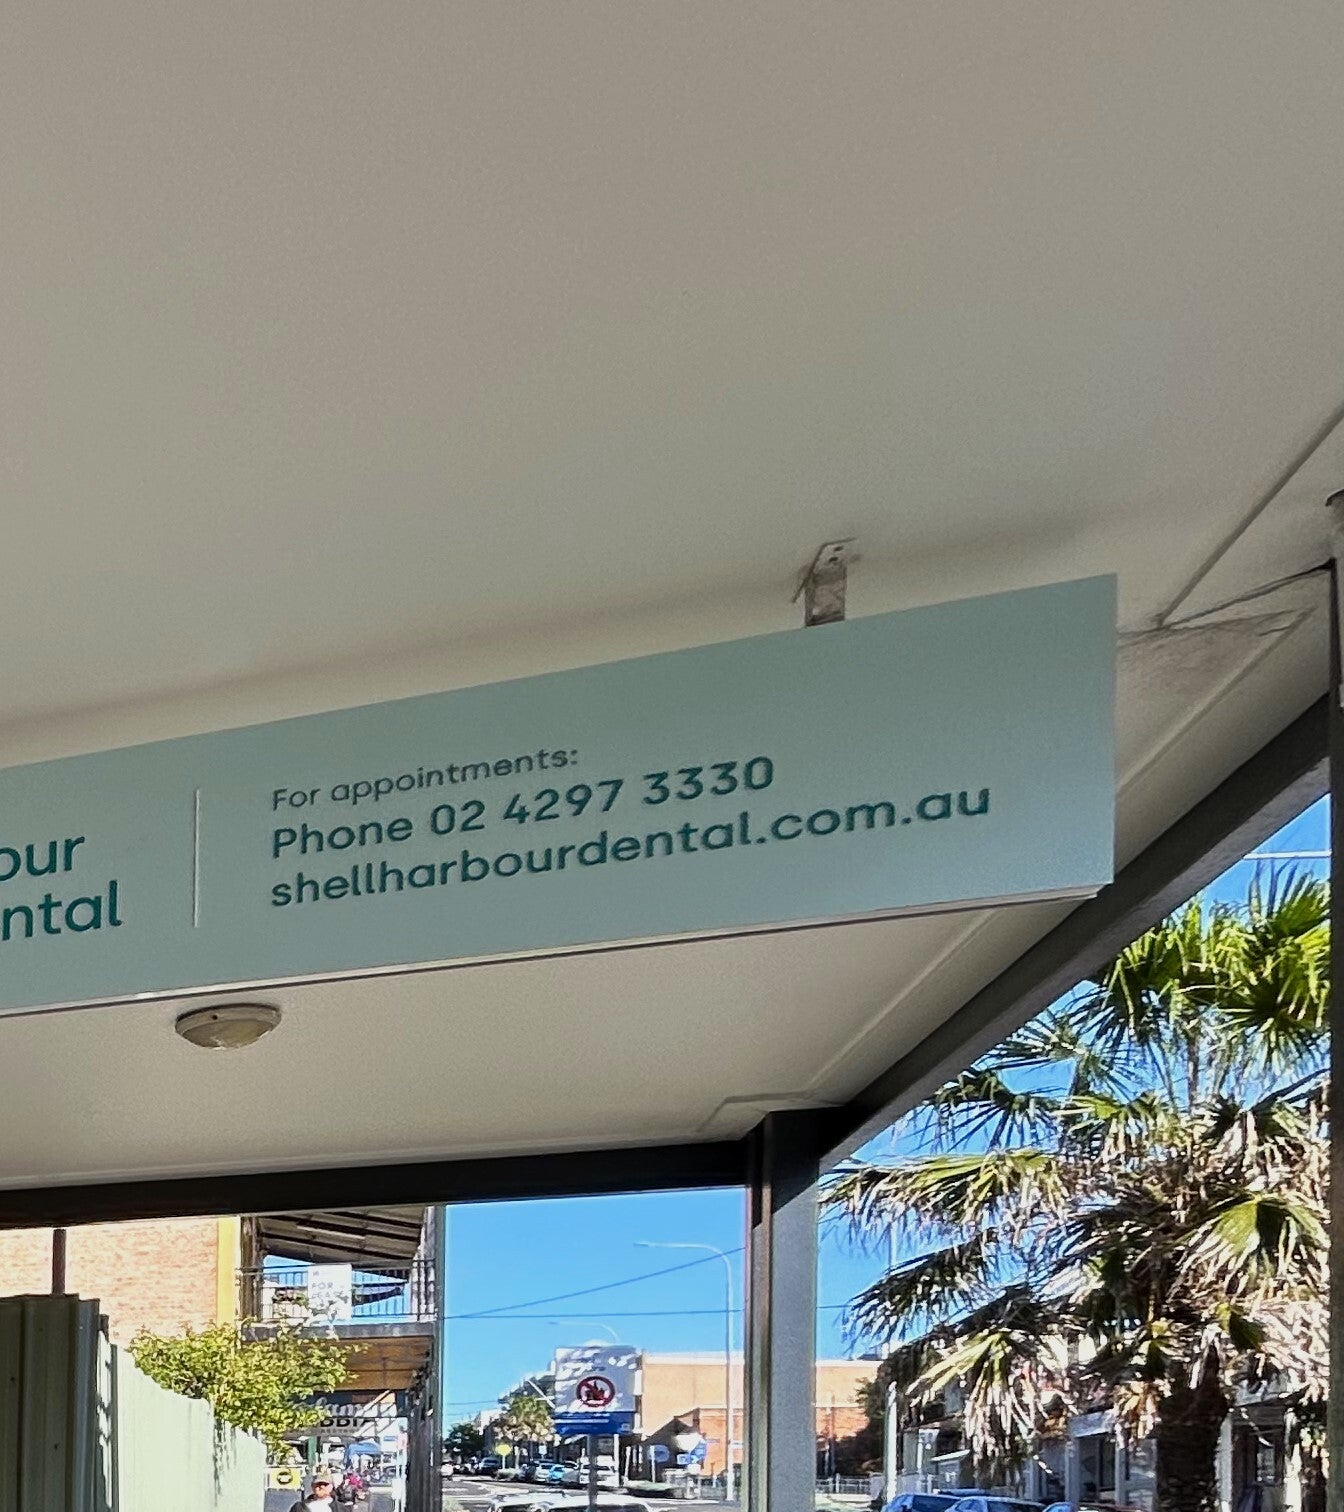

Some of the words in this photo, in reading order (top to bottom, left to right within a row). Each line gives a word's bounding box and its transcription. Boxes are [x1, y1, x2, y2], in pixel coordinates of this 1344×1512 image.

[272, 783, 321, 812] For
[330, 746, 578, 806] appointments:
[272, 810, 415, 859] Phone
[429, 798, 487, 837] 02
[503, 778, 626, 828] 4297
[642, 755, 775, 807] 3330
[271, 786, 992, 908] shellharbourdental.com.au
